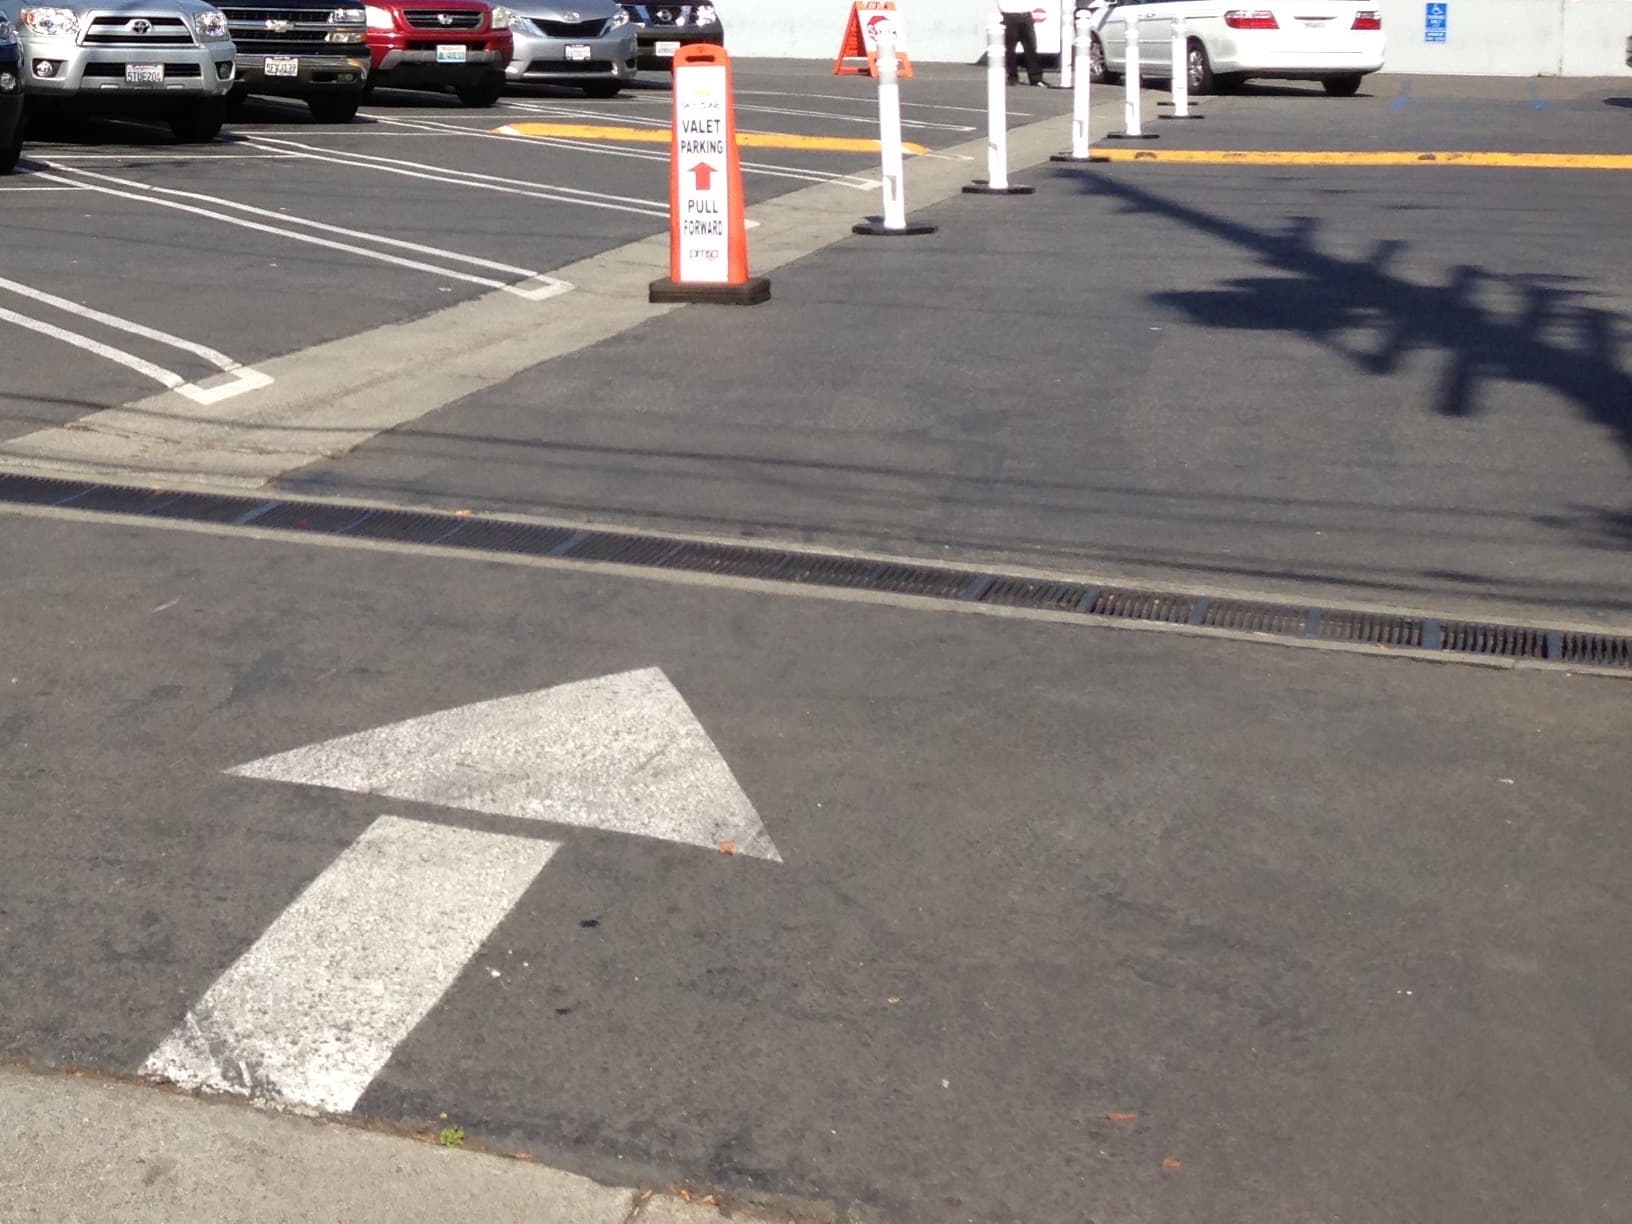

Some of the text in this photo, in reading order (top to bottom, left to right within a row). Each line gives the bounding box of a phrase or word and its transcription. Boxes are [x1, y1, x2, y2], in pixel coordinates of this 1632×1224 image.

[682, 119, 721, 133] VALET
[680, 140, 724, 154] PARKING
[688, 200, 718, 213] PULL
[684, 220, 723, 235] FORWARD
